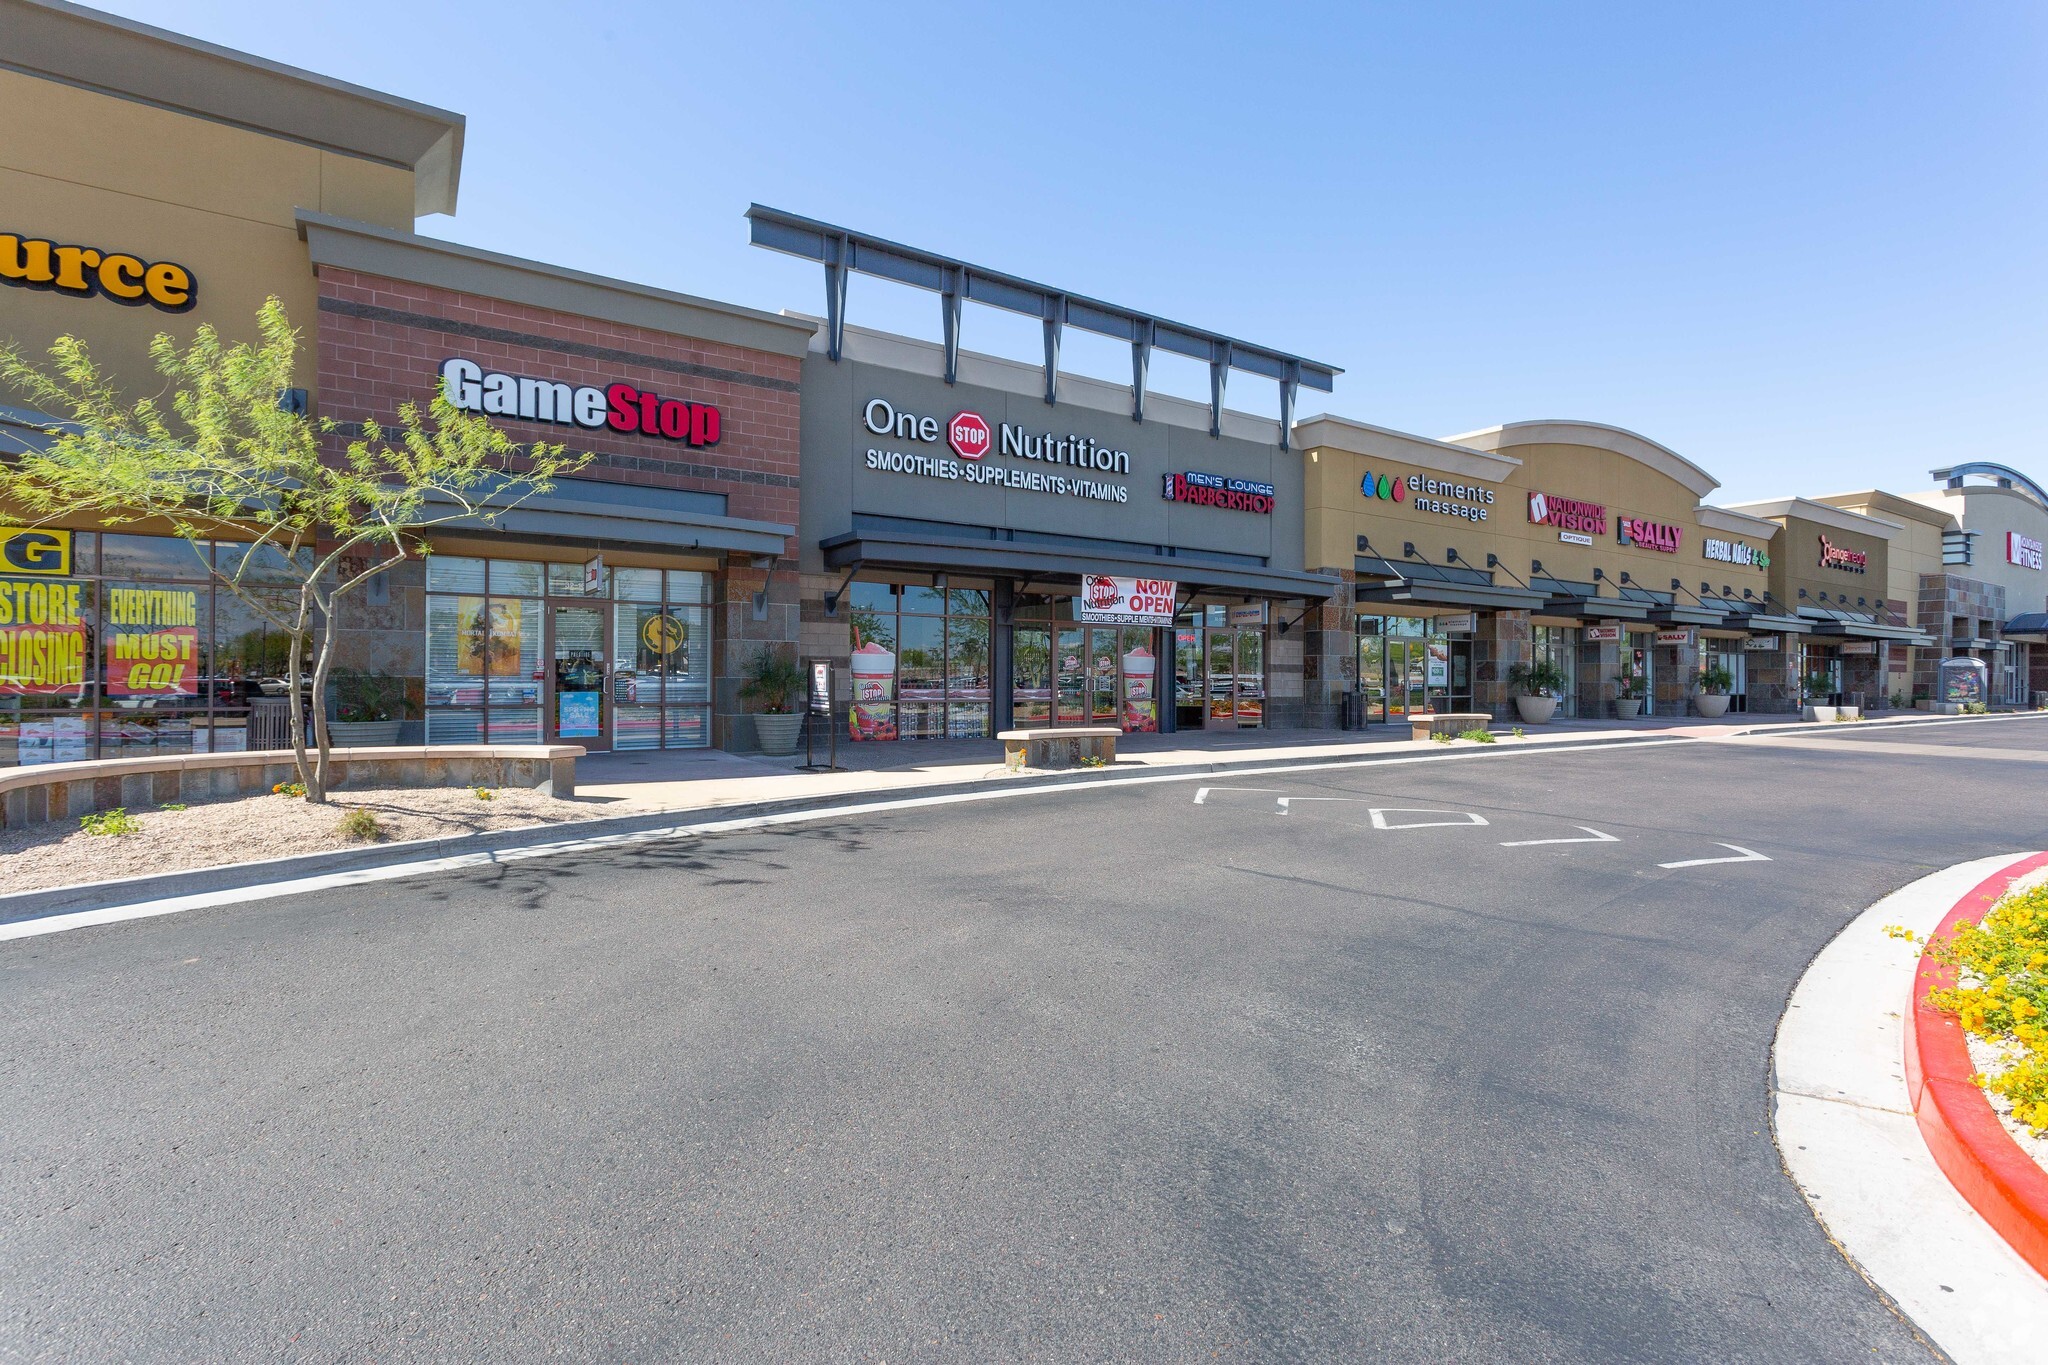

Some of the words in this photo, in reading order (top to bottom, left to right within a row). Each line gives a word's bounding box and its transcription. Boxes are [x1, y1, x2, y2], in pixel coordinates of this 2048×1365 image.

[443, 358, 721, 446] GameStop
[865, 398, 939, 443] One
[955, 426, 985, 445] STOP
[1001, 423, 1131, 474] Nutrition
[1175, 473, 1275, 514] BARBERSHOP
[1187, 472, 1223, 487] MEN'S
[1228, 479, 1274, 495] LOUNGE
[1409, 474, 1494, 504] elements
[1416, 498, 1487, 522] massage
[1549, 496, 1606, 520] NATIONWIDE
[1548, 510, 1606, 535] VISION
[1633, 518, 1683, 548] SALLY
[4, 532, 62, 570] G
[1563, 534, 1591, 544] OPTIQUE
[1705, 538, 1731, 562] HERBAL
[1093, 585, 1115, 599] STOP
[1136, 579, 1173, 596] NOW
[0, 581, 81, 626] STORE
[110, 588, 196, 627] EVERYTHING
[1129, 595, 1173, 614] OPEN
[116, 633, 194, 660] MUST
[1177, 634, 1196, 642] OPEN
[0, 630, 83, 686] CLOSING
[127, 663, 185, 690] GO!
[864, 689, 882, 699] STOP
